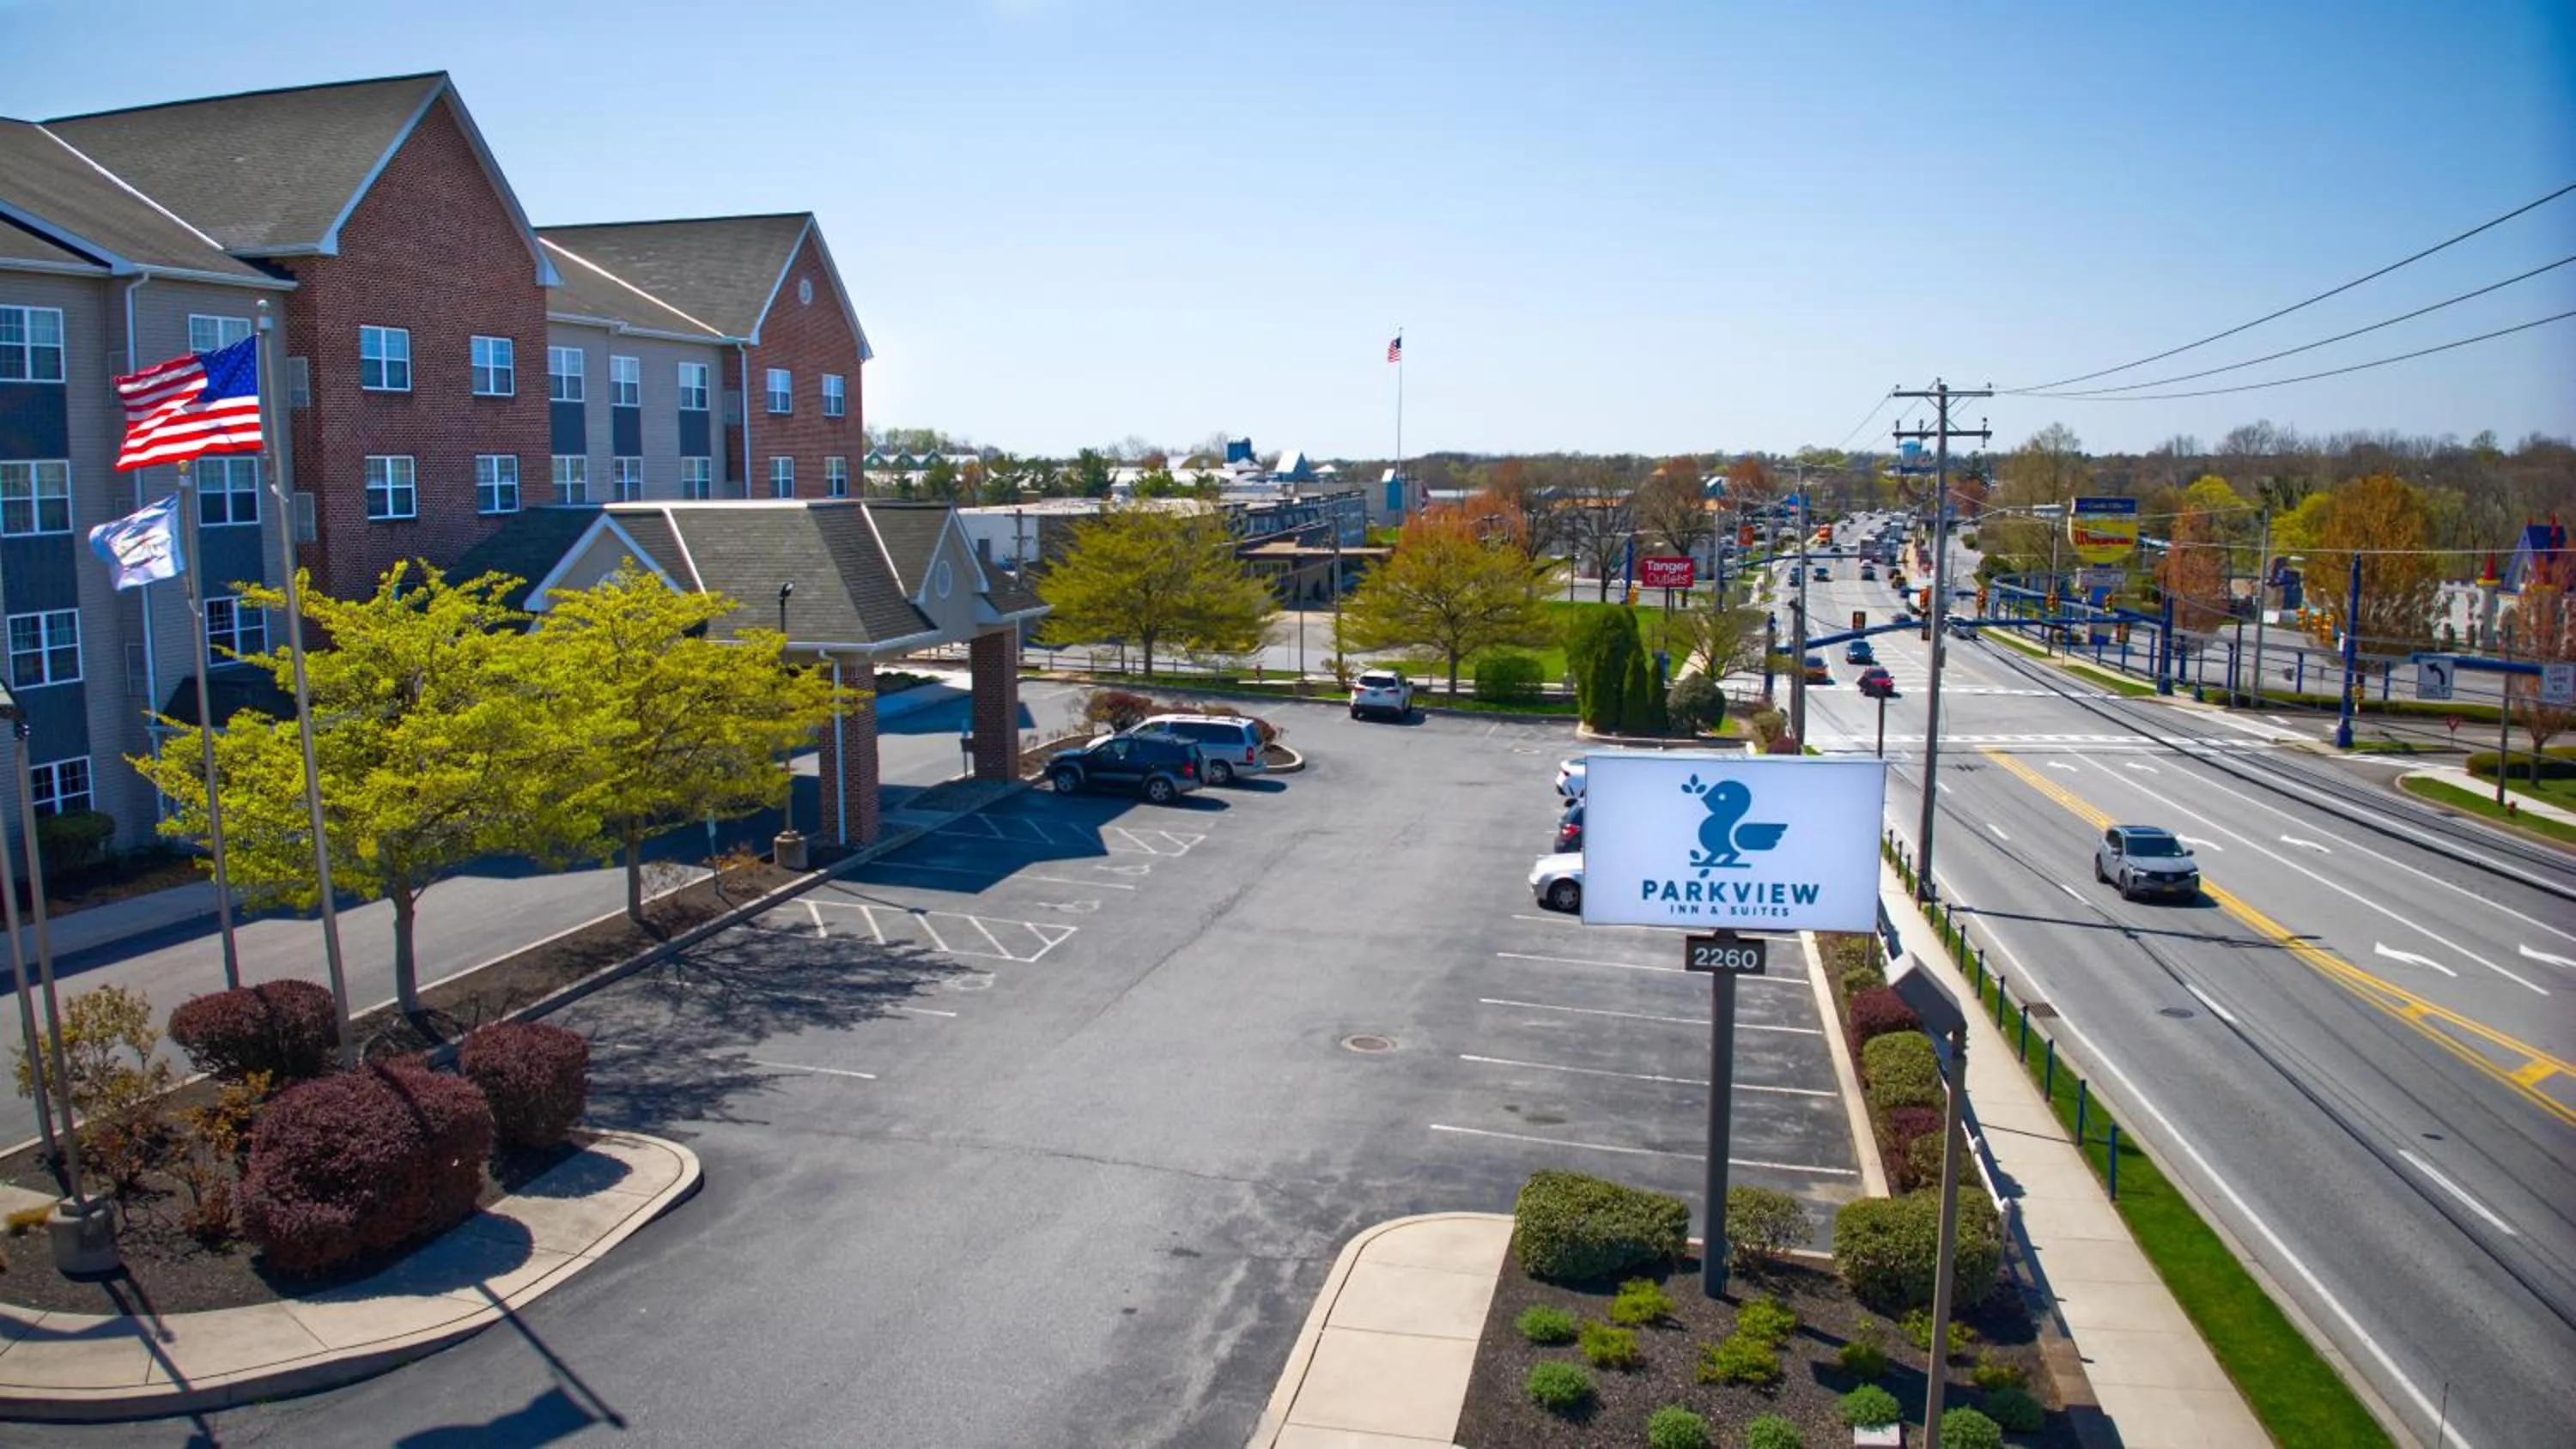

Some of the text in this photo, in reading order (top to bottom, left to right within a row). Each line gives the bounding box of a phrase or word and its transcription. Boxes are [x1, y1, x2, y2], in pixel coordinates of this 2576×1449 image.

[1646, 561, 1691, 574] Tanger
[1642, 879, 1820, 905] PARKVIEW
[1670, 905, 1789, 917] INN & SUITES
[1694, 947, 1758, 969] 2260
